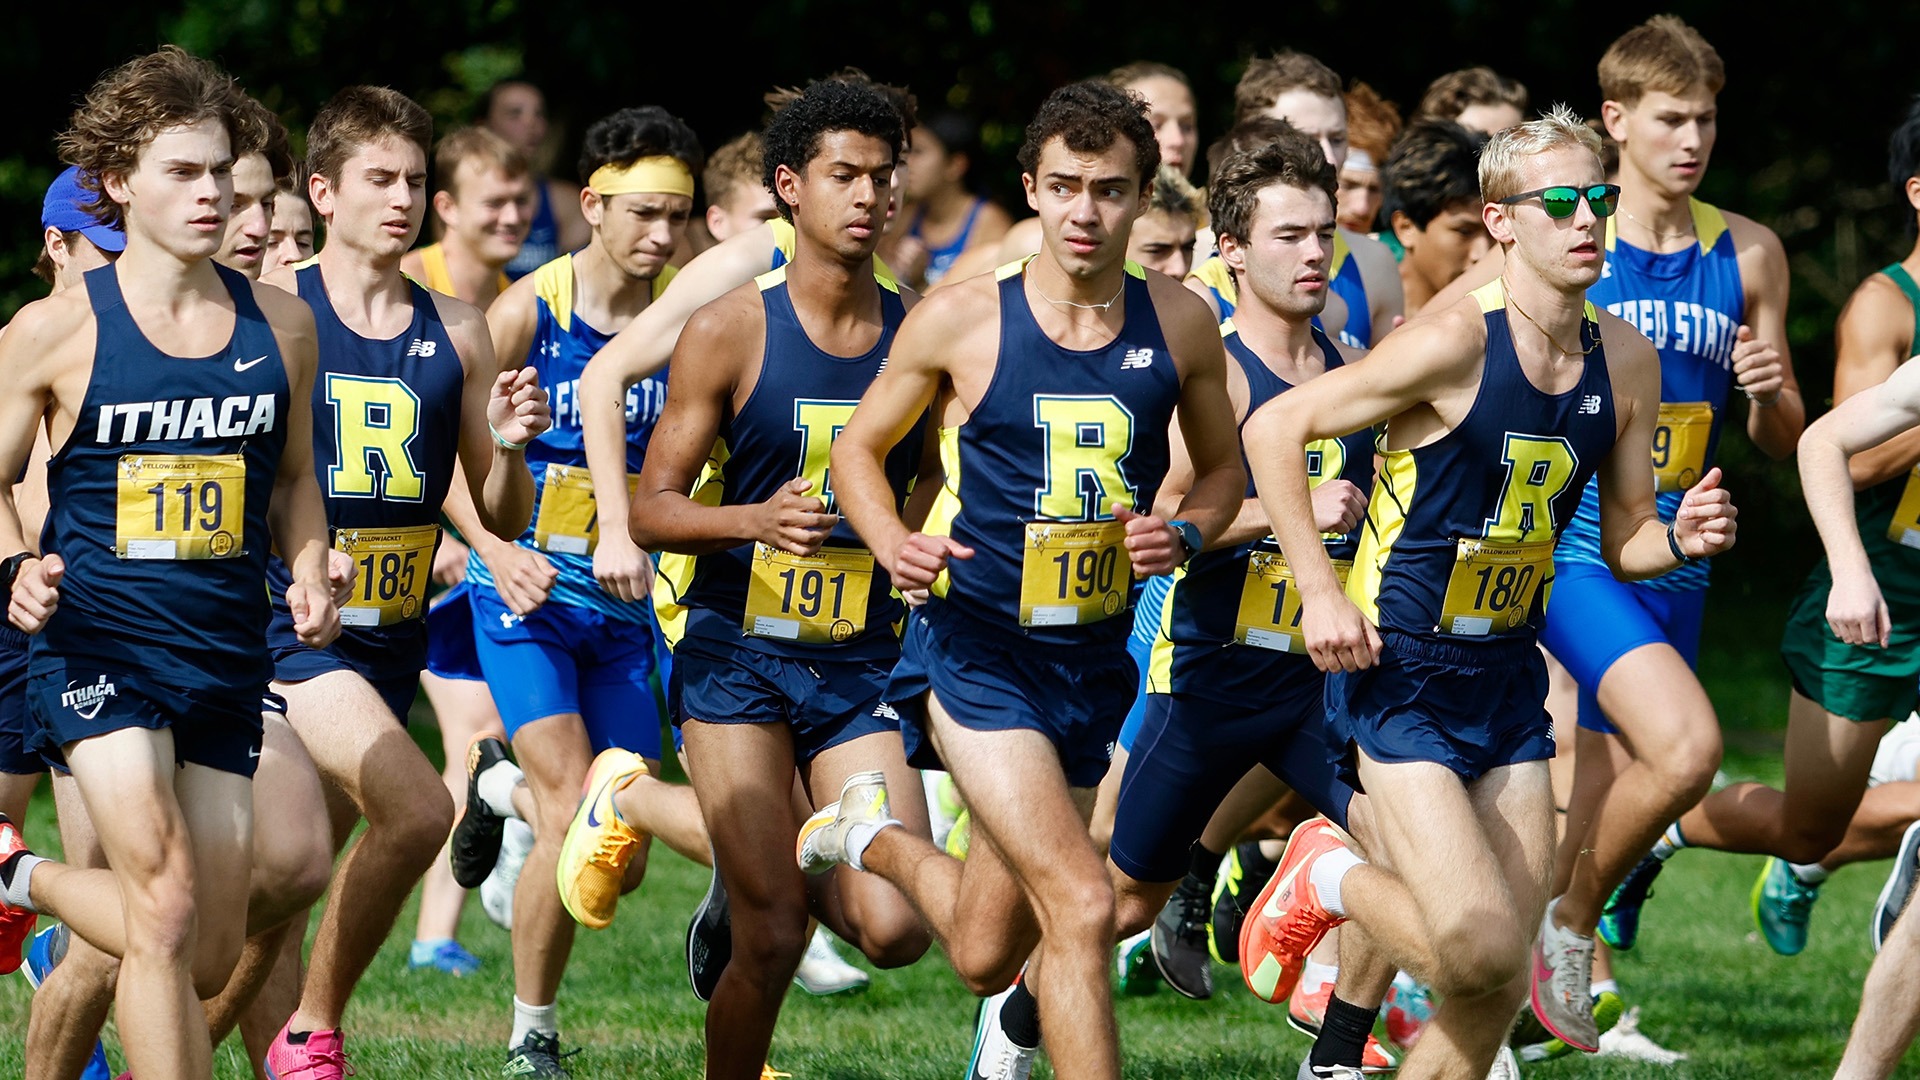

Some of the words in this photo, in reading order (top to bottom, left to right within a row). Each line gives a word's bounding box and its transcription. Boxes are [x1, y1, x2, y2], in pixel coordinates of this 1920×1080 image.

[96, 393, 276, 443] ITHACA
[325, 371, 426, 504] R
[1033, 393, 1139, 522] R
[147, 481, 223, 532] 119
[1480, 431, 1580, 543] R
[360, 551, 418, 601] 185
[779, 568, 846, 619] 191
[1052, 545, 1118, 600] 190
[1473, 564, 1535, 612] 180
[61, 683, 116, 707] ITHACA
